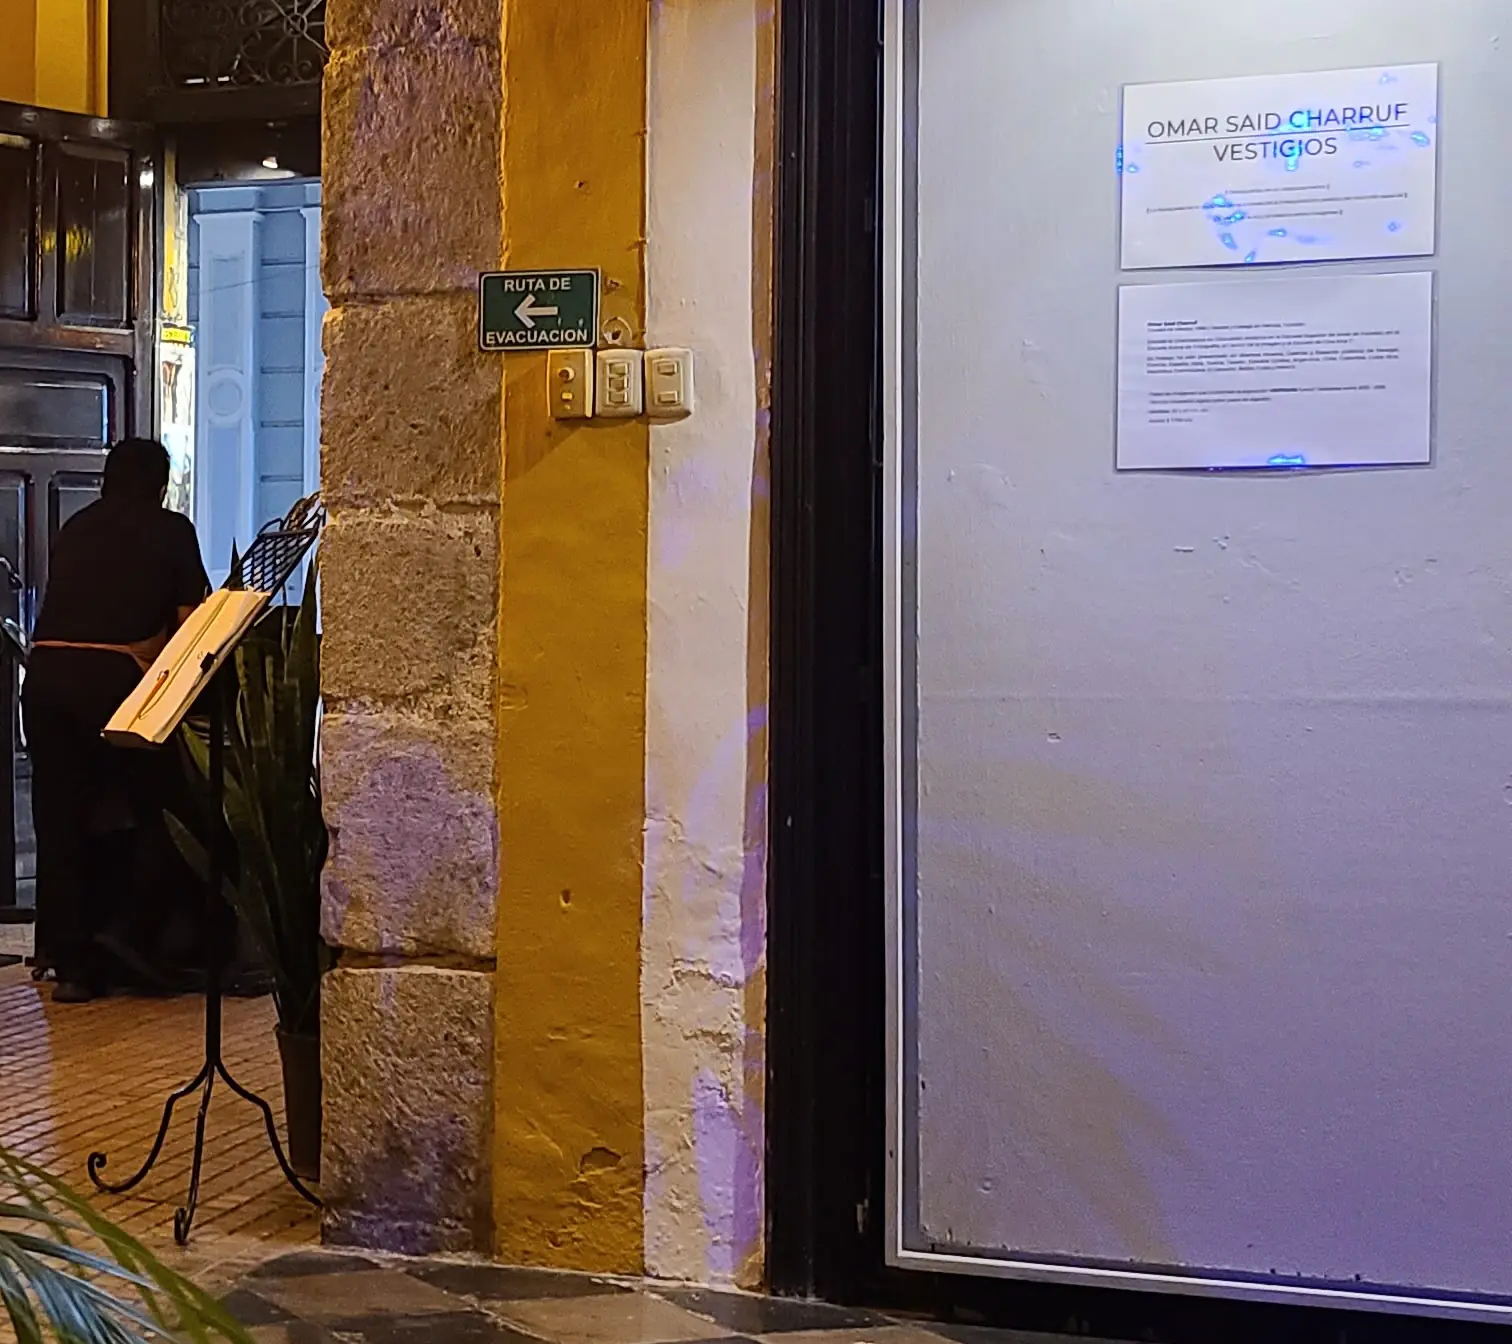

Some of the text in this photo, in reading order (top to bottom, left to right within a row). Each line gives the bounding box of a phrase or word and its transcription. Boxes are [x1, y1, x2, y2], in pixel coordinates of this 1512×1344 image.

[1147, 103, 1408, 138] OMAR SAID CHARRUF
[1213, 137, 1338, 162] VESTIGIOS
[504, 277, 571, 292] RUTA DE
[486, 329, 588, 344] EVACUACION
